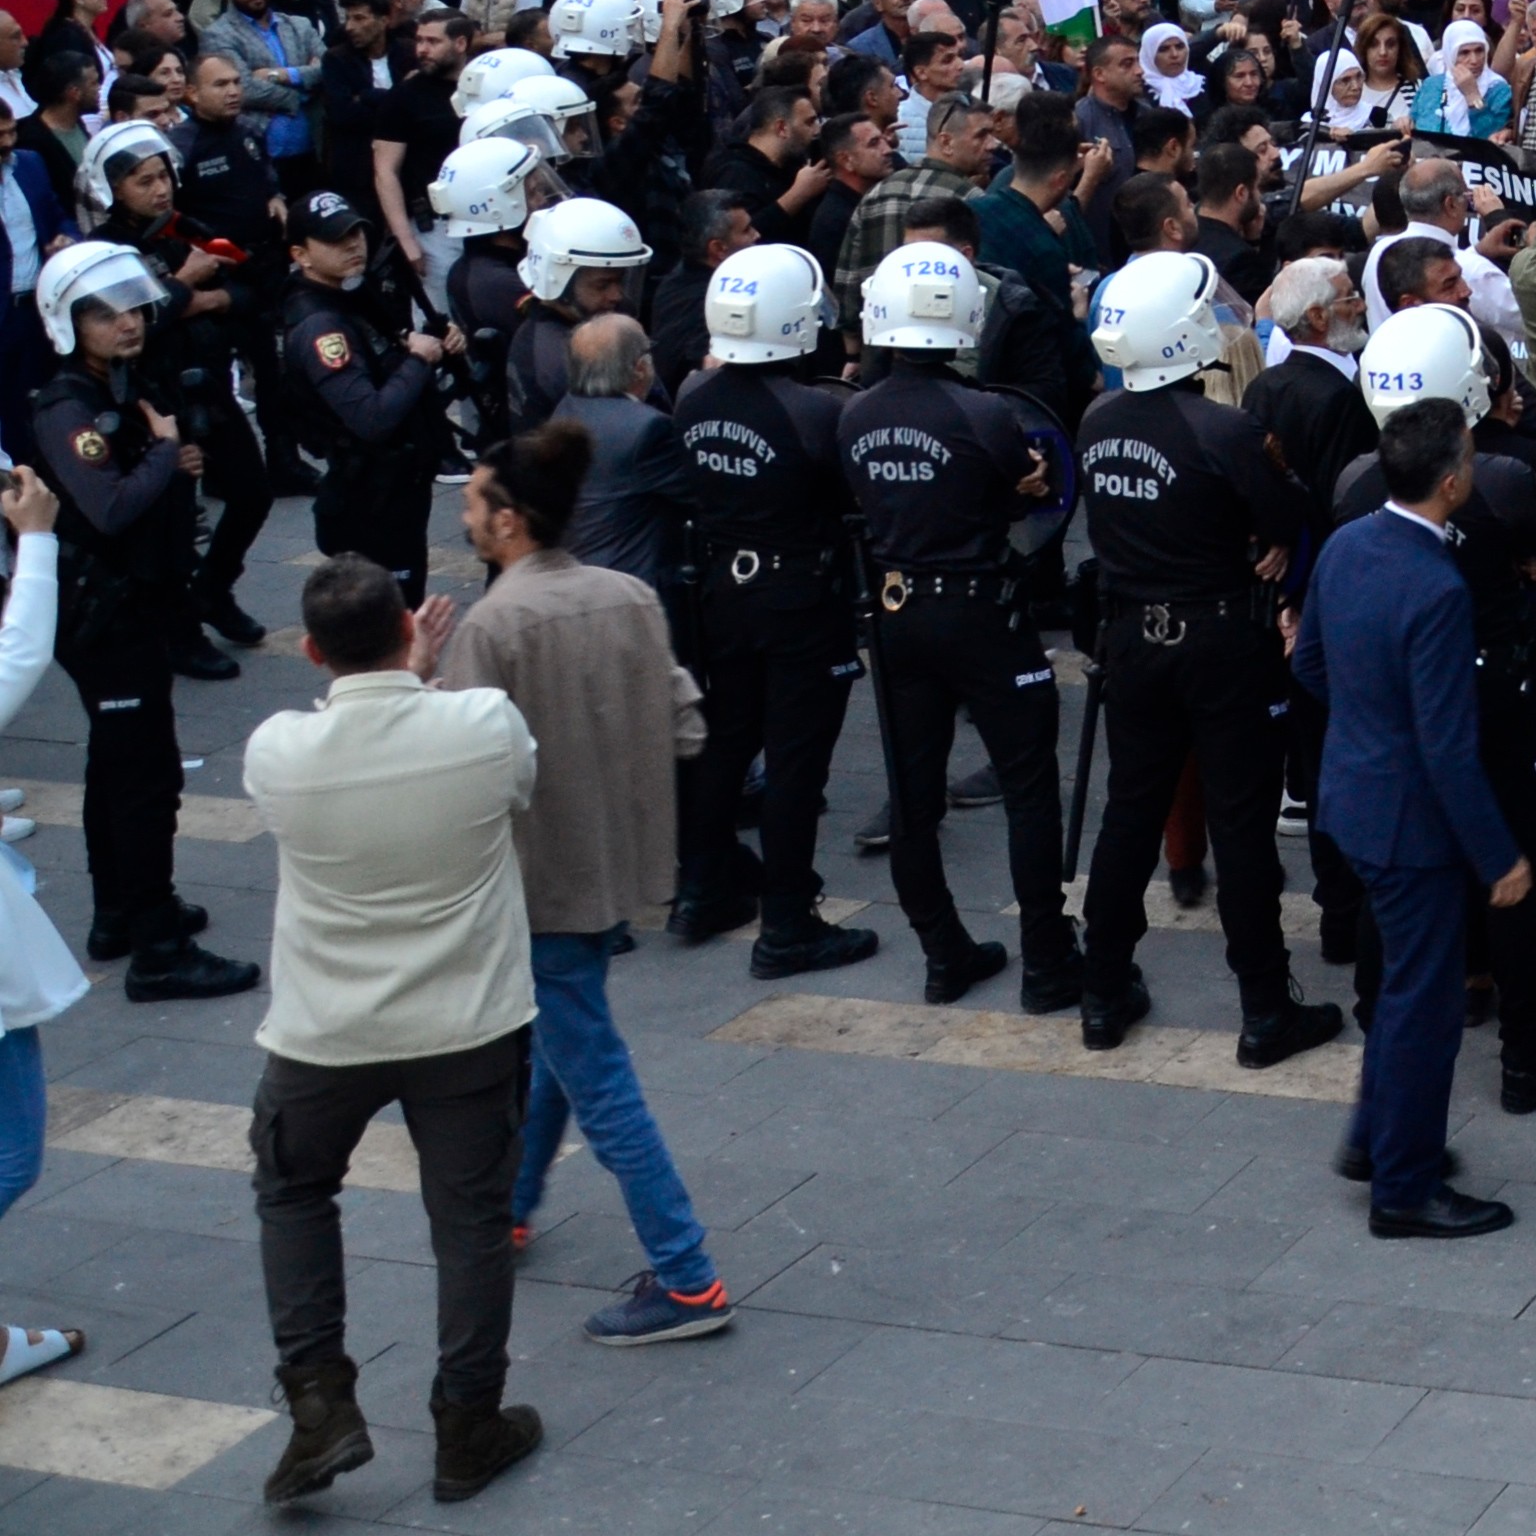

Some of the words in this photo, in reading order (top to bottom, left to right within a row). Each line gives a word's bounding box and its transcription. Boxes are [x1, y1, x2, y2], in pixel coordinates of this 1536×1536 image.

[601, 29, 616, 40] 01
[469, 201, 490, 216] 01
[902, 260, 961, 280] T284
[718, 276, 760, 297] T24
[873, 305, 888, 321] 01
[782, 320, 803, 337] 01
[1161, 339, 1186, 360] 01
[1368, 370, 1424, 392] T213
[683, 420, 722, 451] ÇEVİK
[722, 420, 777, 465] KUVVET
[850, 426, 892, 466] ÇEVİK
[893, 426, 953, 466] KUVVET
[696, 449, 759, 478] POLİS
[867, 460, 936, 482] POLİS
[1081, 438, 1122, 476] ÇEVİK
[1122, 438, 1177, 487] KUVVET
[1093, 471, 1160, 502] POLİS
